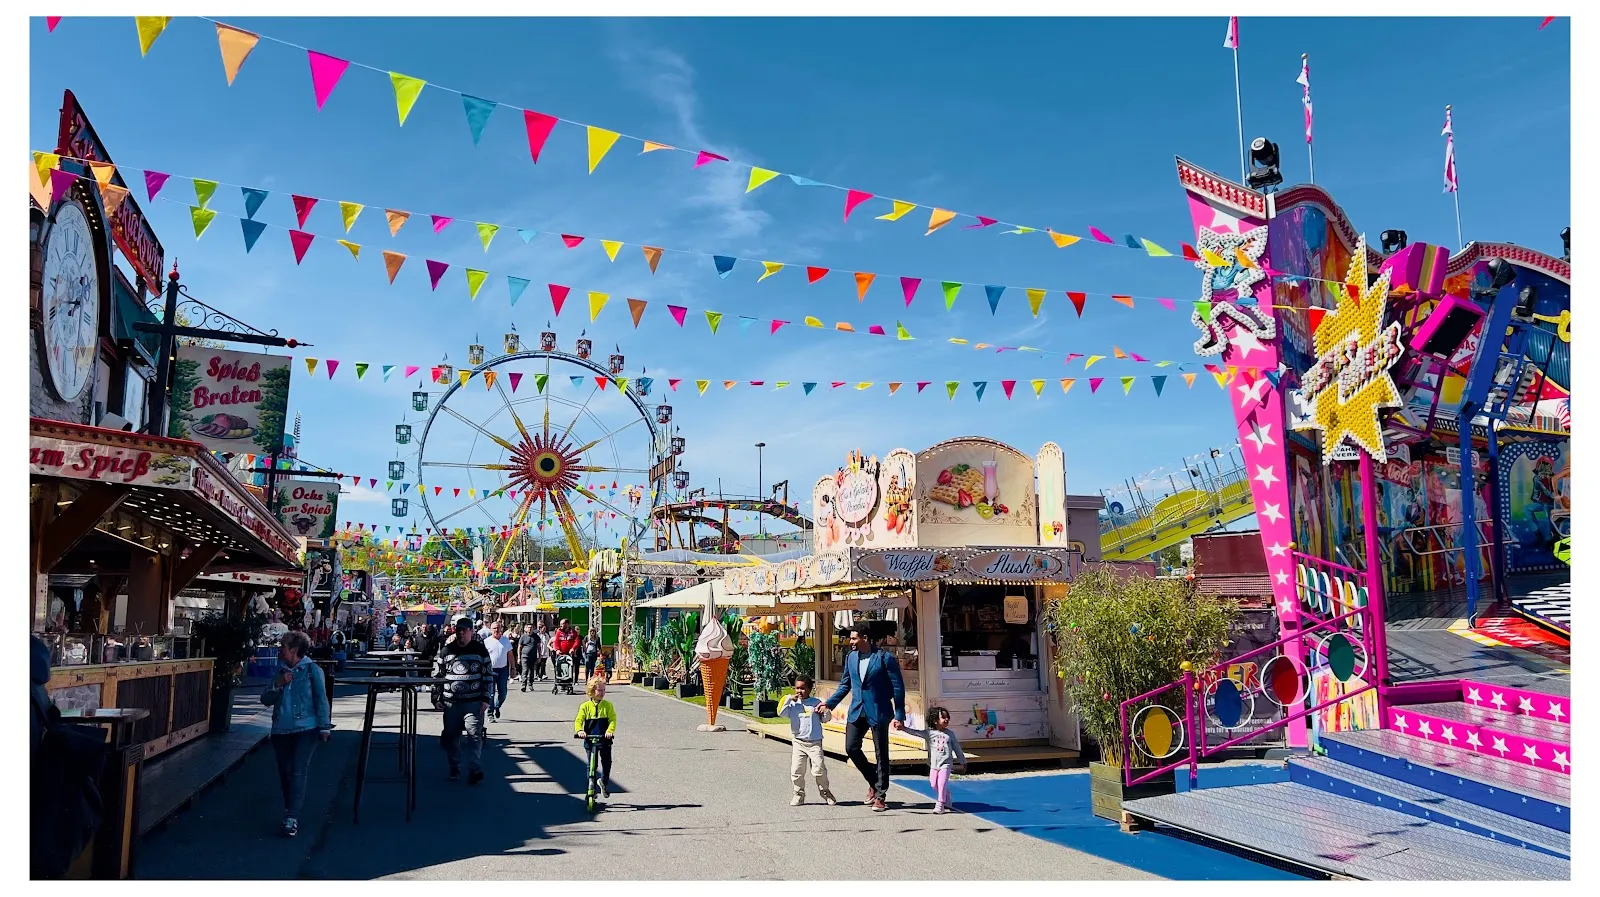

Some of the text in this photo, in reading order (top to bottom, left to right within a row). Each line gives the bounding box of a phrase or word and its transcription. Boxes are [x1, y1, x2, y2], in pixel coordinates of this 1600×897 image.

[206, 356, 261, 382] Spieß
[193, 385, 263, 409] Braten
[72, 448, 152, 482] Spieß
[292, 487, 324, 500] Ochs
[300, 503, 331, 515] Spieß
[884, 554, 934, 578] Waffel
[986, 553, 1034, 574] Slush
